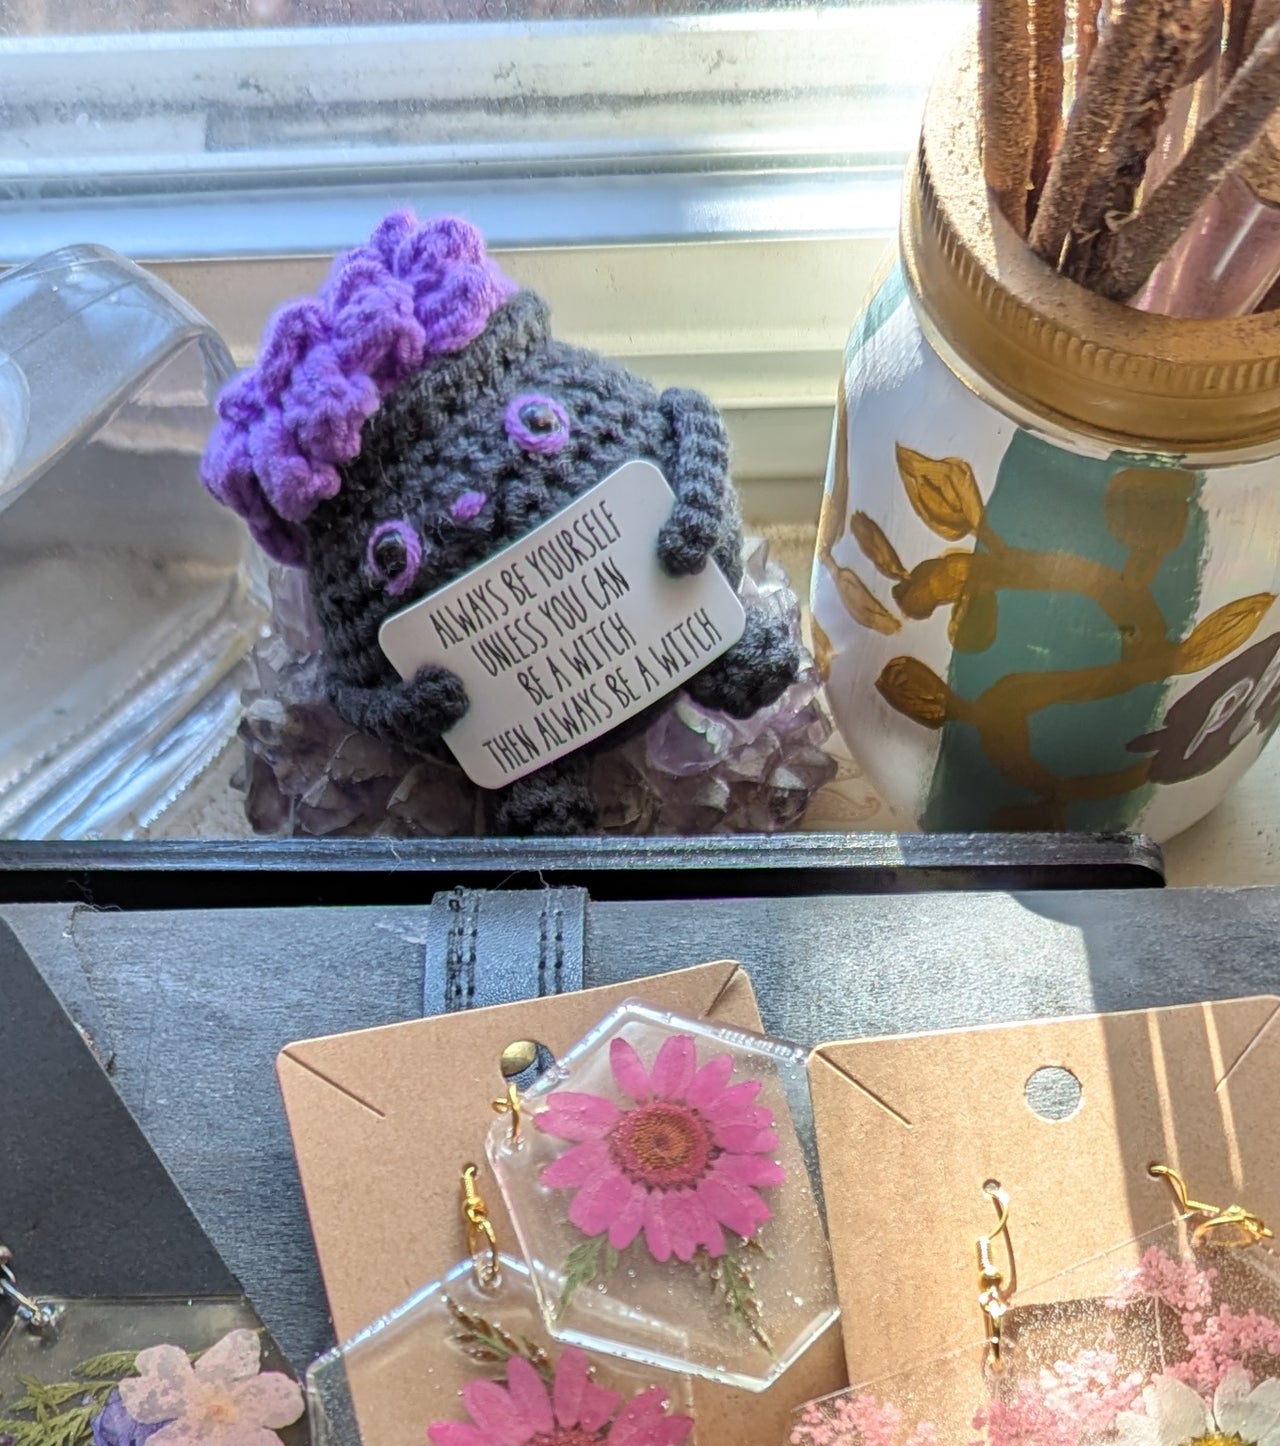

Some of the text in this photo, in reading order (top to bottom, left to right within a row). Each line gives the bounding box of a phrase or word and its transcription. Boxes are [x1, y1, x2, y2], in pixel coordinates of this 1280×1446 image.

[429, 500, 622, 650] ALWAYS BE YOURSELF
[471, 556, 631, 677] UNLESS YOU CAN
[482, 608, 723, 774] THEN ALWAYS BE A WITCH
[517, 612, 637, 706] BE A WITCH
